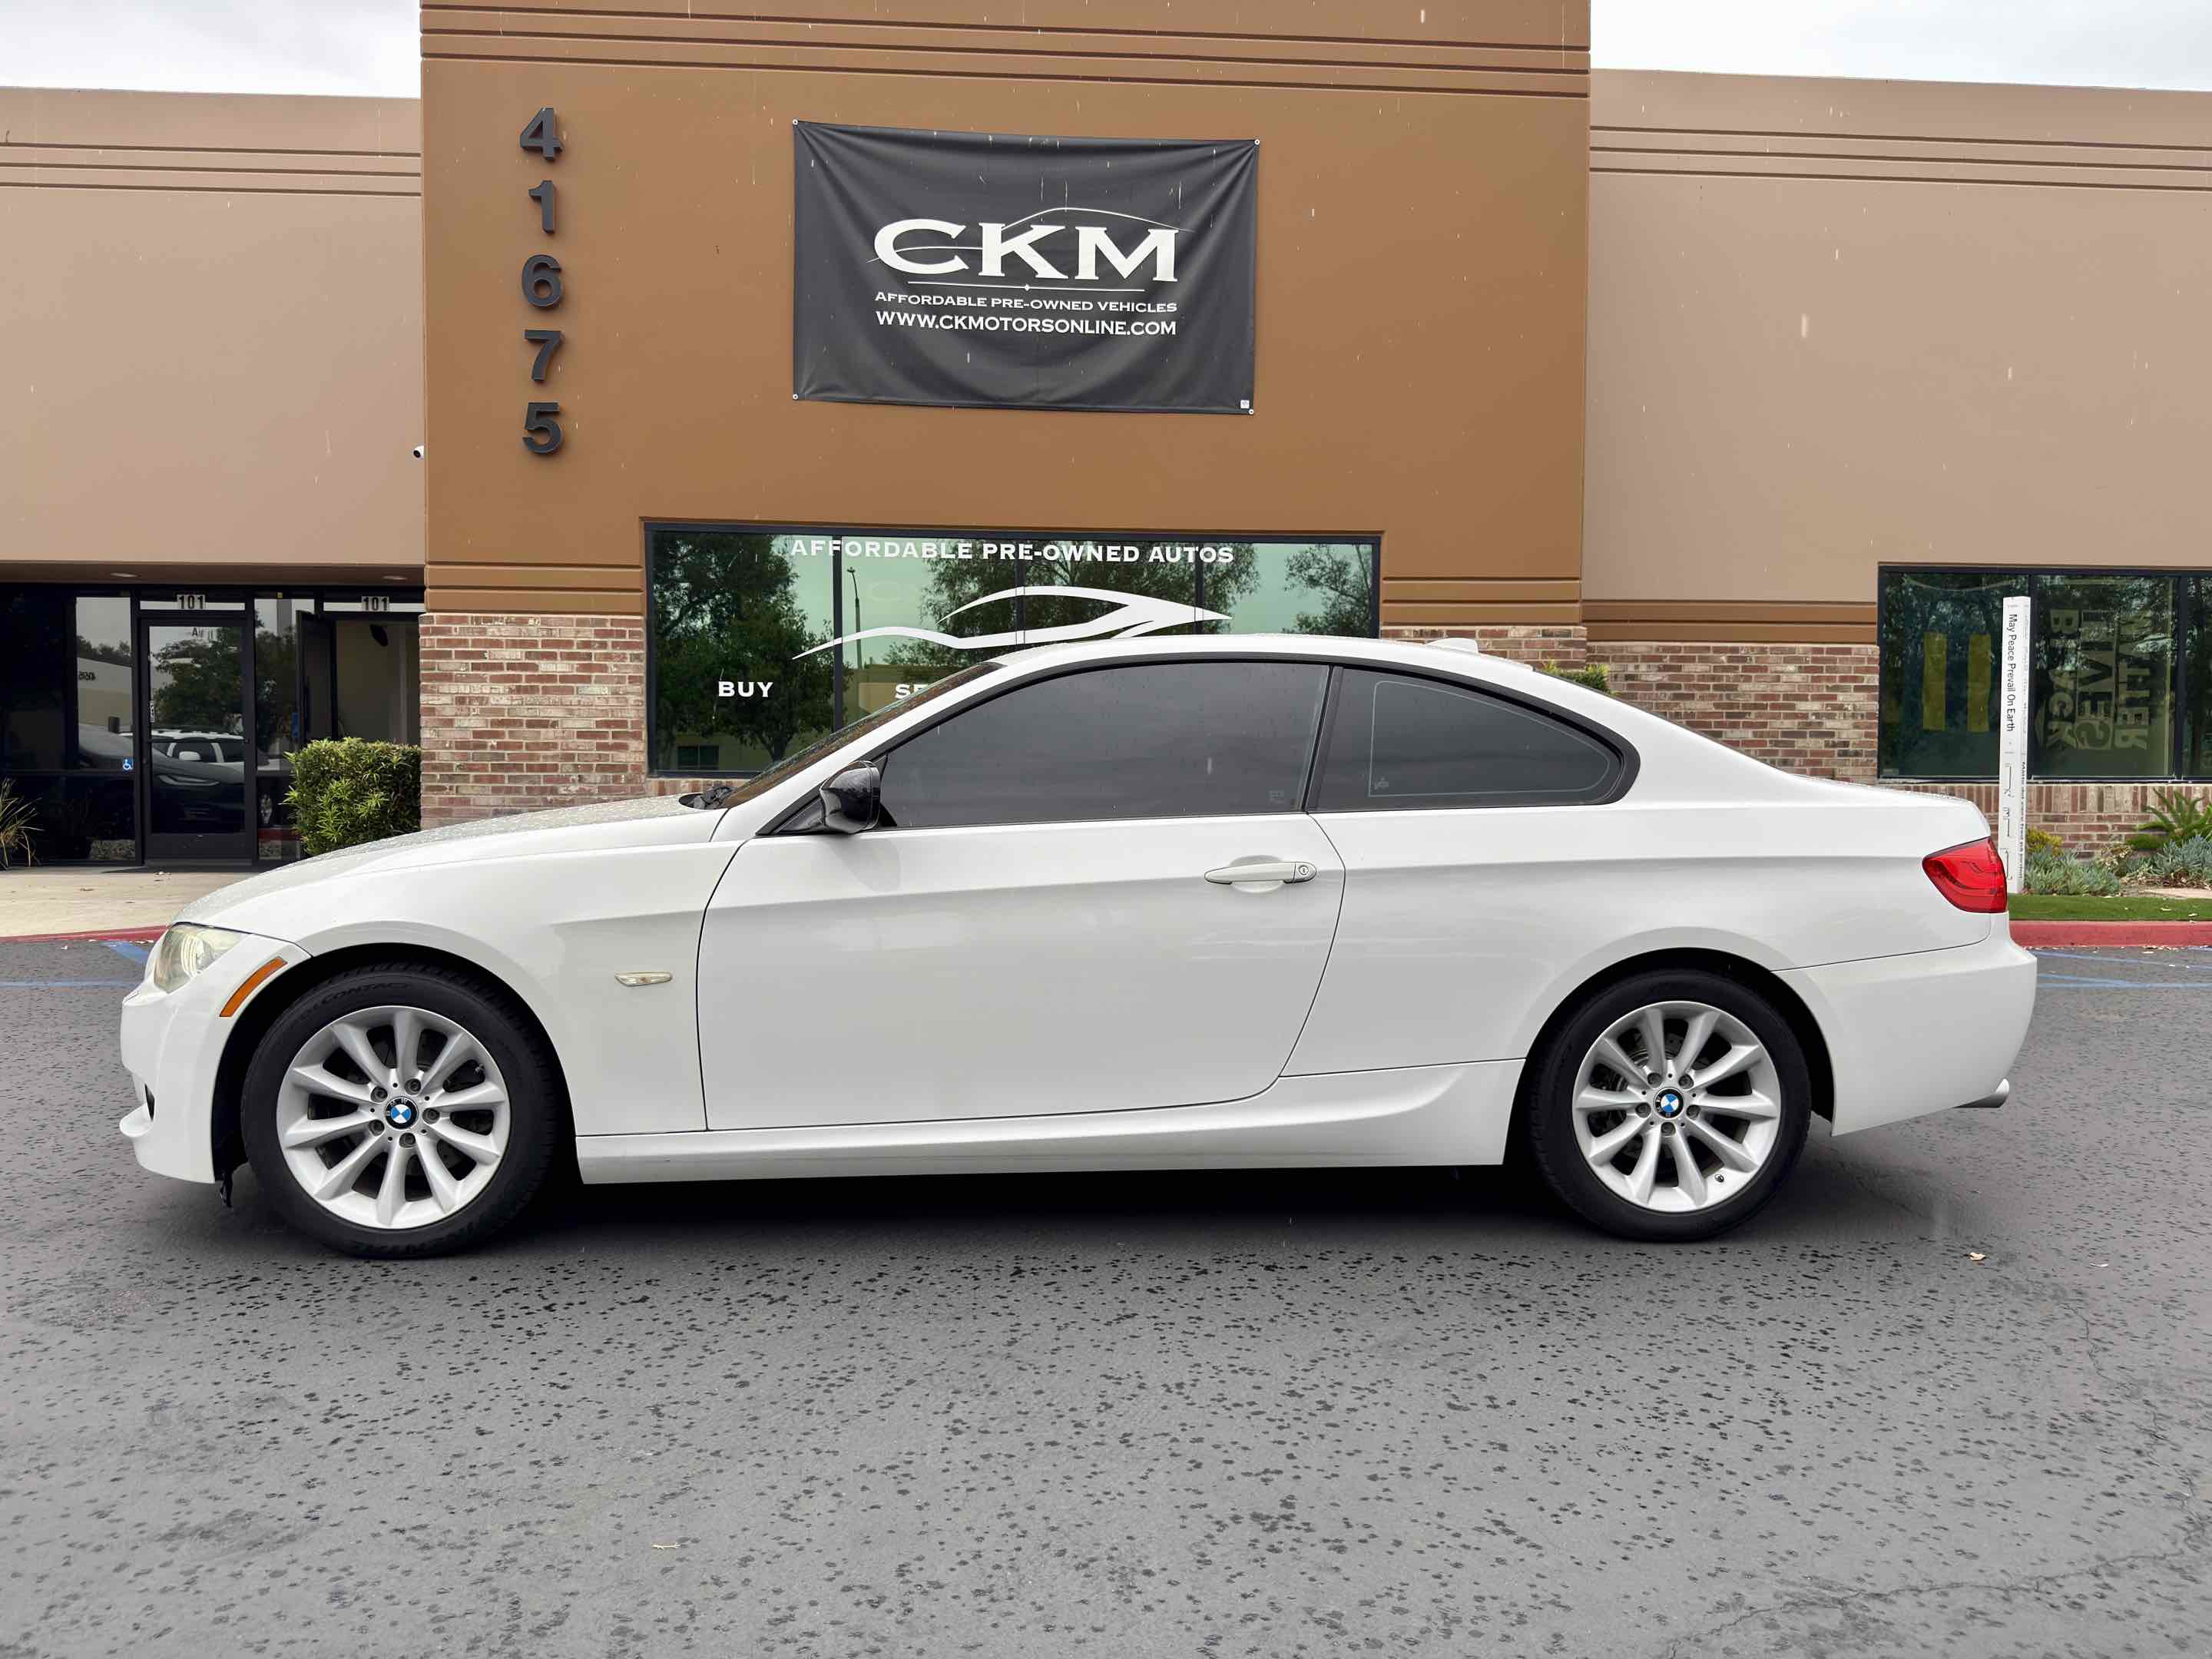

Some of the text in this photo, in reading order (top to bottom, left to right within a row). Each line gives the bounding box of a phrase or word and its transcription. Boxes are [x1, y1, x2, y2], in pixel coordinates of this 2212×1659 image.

[874, 219, 1178, 282] CKM
[875, 292, 1177, 313] AFFORDABLE PRE-OWNED VEHICLES
[876, 310, 1177, 336] WWW.CKMOTORSONLINE.COM
[791, 539, 1233, 563] AFFORDABLE PRE-OWNED AUTOS
[179, 595, 204, 609] 101
[363, 596, 388, 611] 101
[2006, 614, 2018, 732] May Peace Prevail On Earth
[718, 681, 773, 697] BUY
